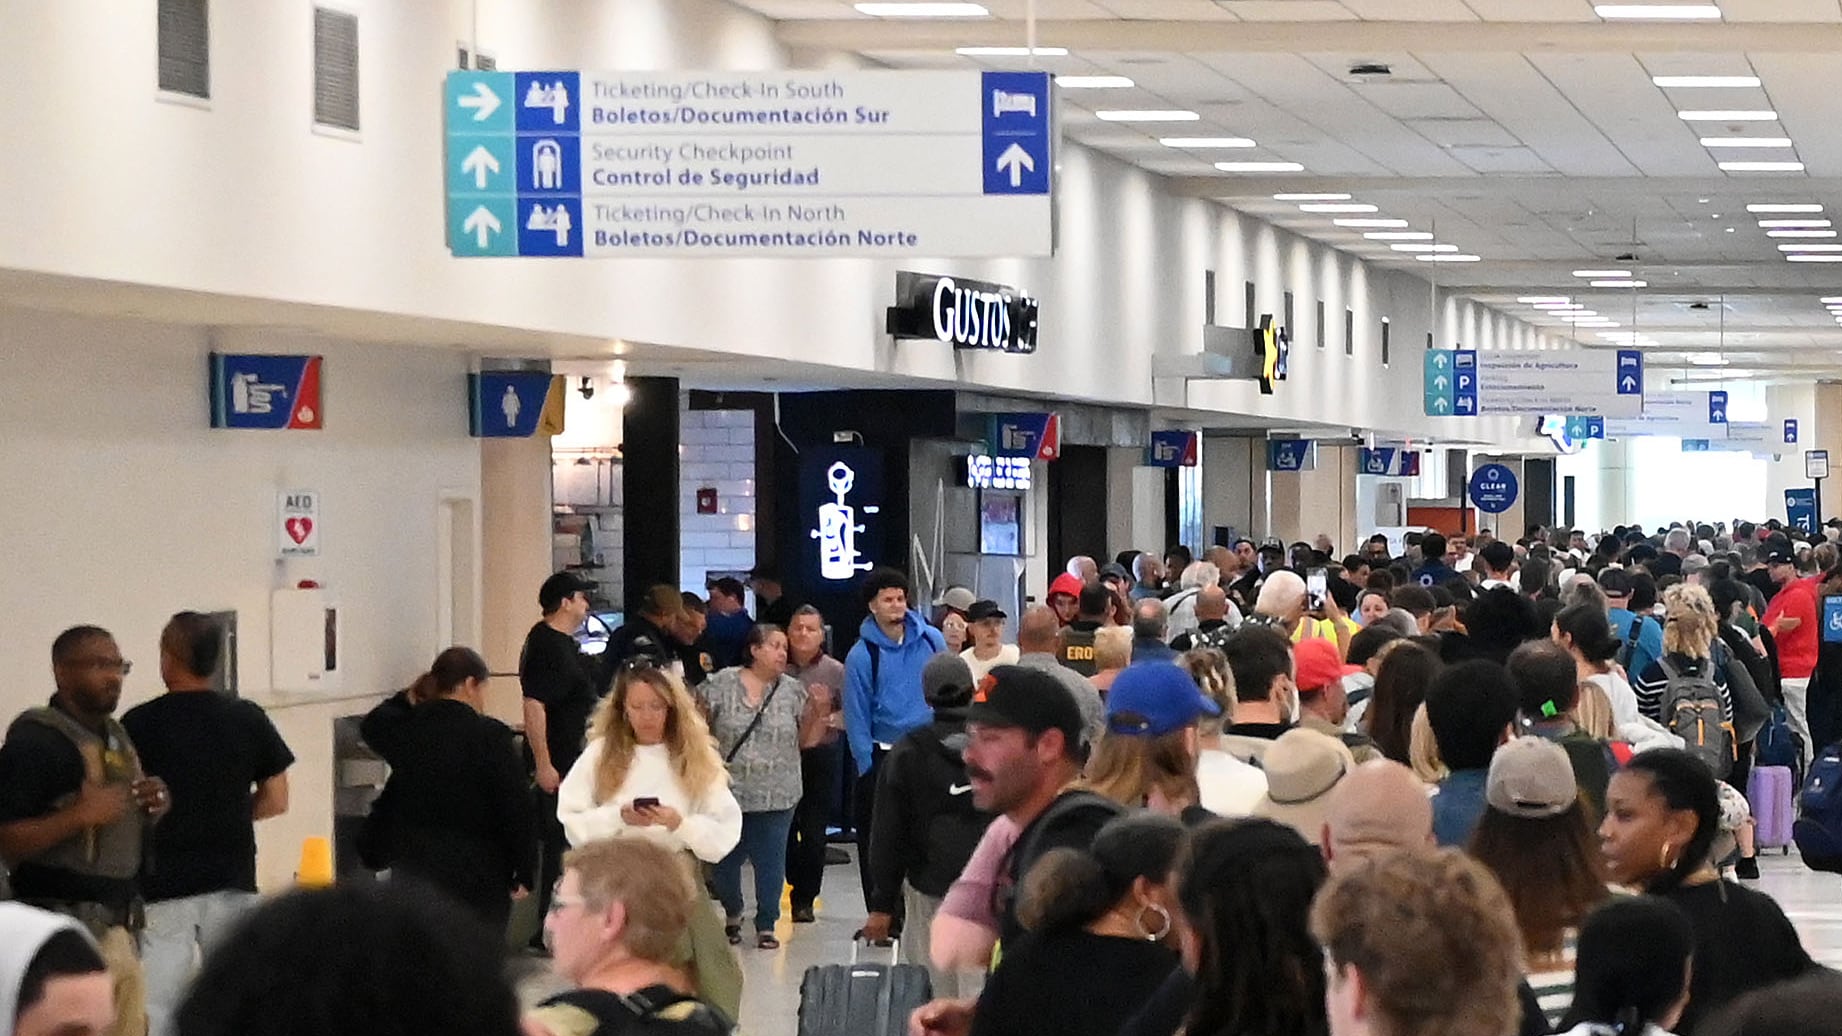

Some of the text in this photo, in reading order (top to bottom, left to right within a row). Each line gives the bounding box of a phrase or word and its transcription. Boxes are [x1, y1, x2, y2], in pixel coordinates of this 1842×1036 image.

[592, 80, 845, 101] Ticketing/Check-In South
[592, 105, 891, 126] Boletos/Documentación Sur
[592, 142, 793, 163] Security Checkpoint
[592, 167, 820, 189] Control de Seguridad
[594, 204, 846, 224] Ticketing/Check-In North
[594, 228, 918, 250] Boletos/Documentación Norte
[1067, 646, 1093, 660] ERO
